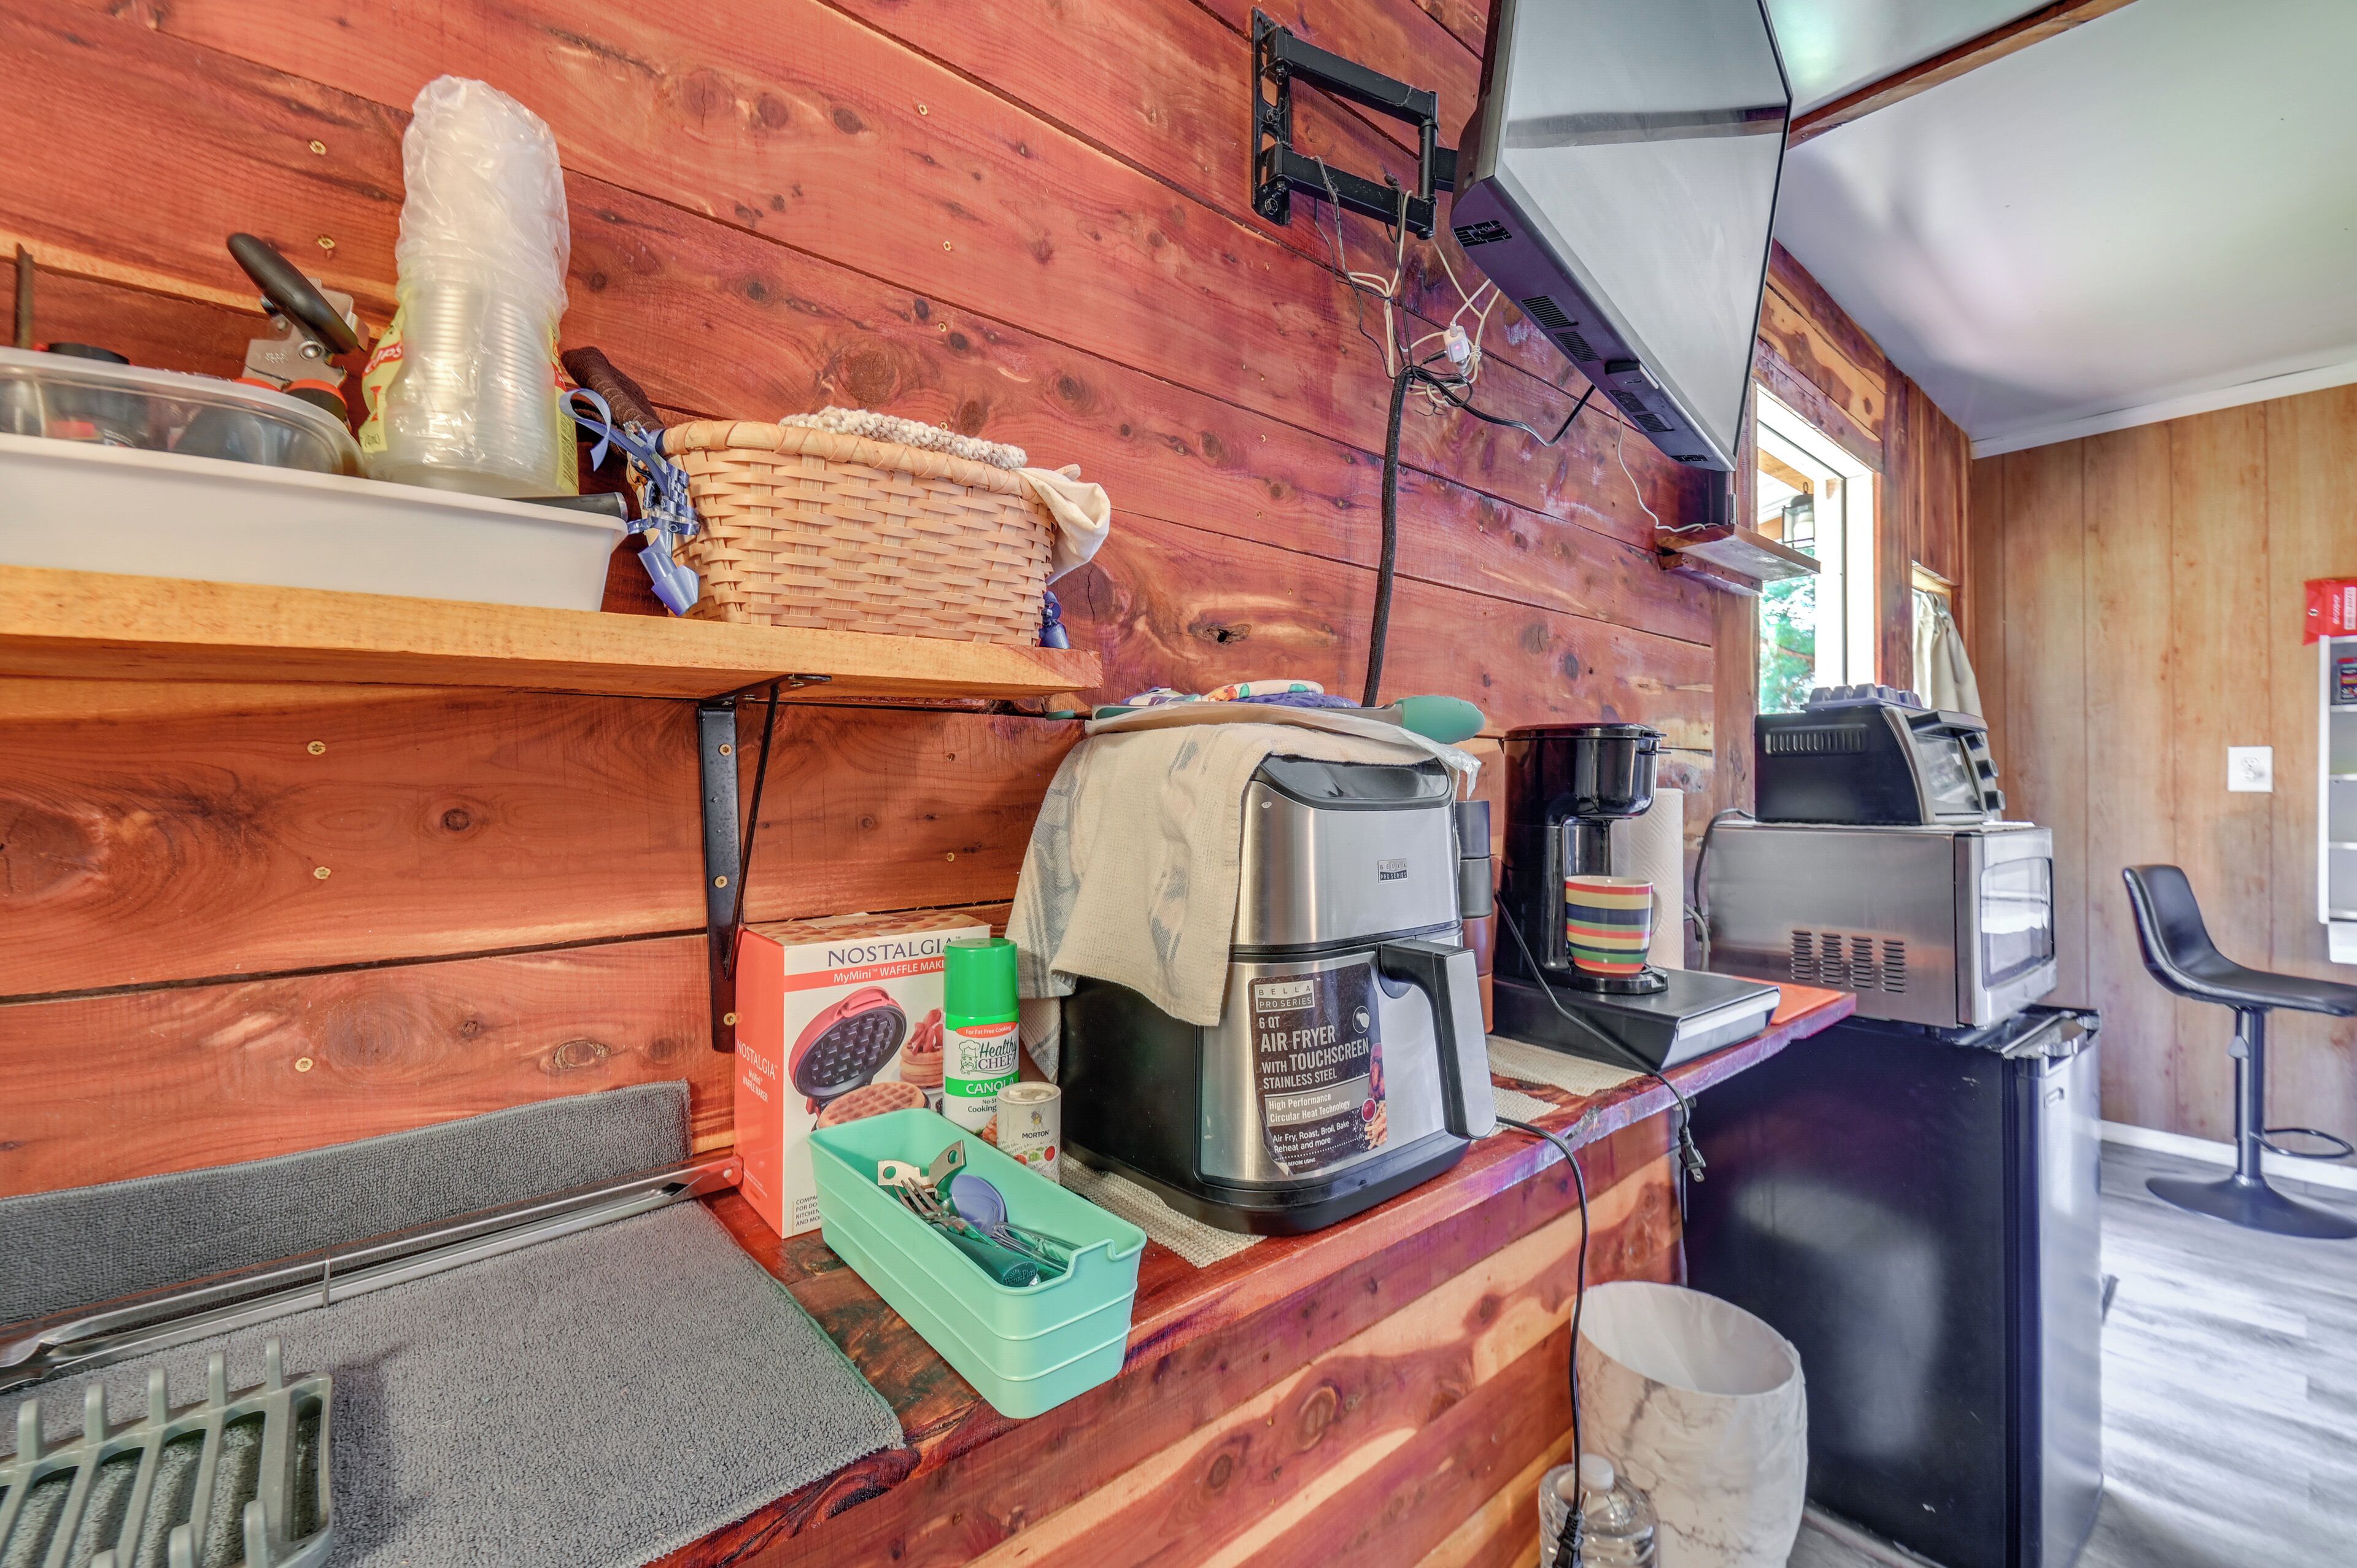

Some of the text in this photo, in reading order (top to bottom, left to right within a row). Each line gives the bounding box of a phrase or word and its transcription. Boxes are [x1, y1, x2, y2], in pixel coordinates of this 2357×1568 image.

[880, 963, 918, 977] WAFFLE
[1259, 985, 1310, 995] BELLA
[1280, 997, 1312, 1007] SERIES
[1259, 1016, 1280, 1029] 6 QT
[1261, 1025, 1336, 1052] AIR FRYER
[980, 1036, 1017, 1060] Healthy
[1261, 1037, 1369, 1074] WITH TOUCHSCREEN
[978, 1053, 1013, 1070] CHEF
[1263, 1067, 1337, 1090] STAINLESS STEEL
[755, 1085, 768, 1103] MAKER
[1269, 1093, 1331, 1111] High Performance
[968, 1104, 997, 1113] Cooking
[1270, 1100, 1350, 1123] Circular Heat Technology
[1022, 1130, 1049, 1139] MORTON
[1272, 1120, 1349, 1143] Air Fry, Roast, Broil, Bake
[1274, 1137, 1331, 1154] Reheat and more
[795, 1218, 808, 1227] AND
